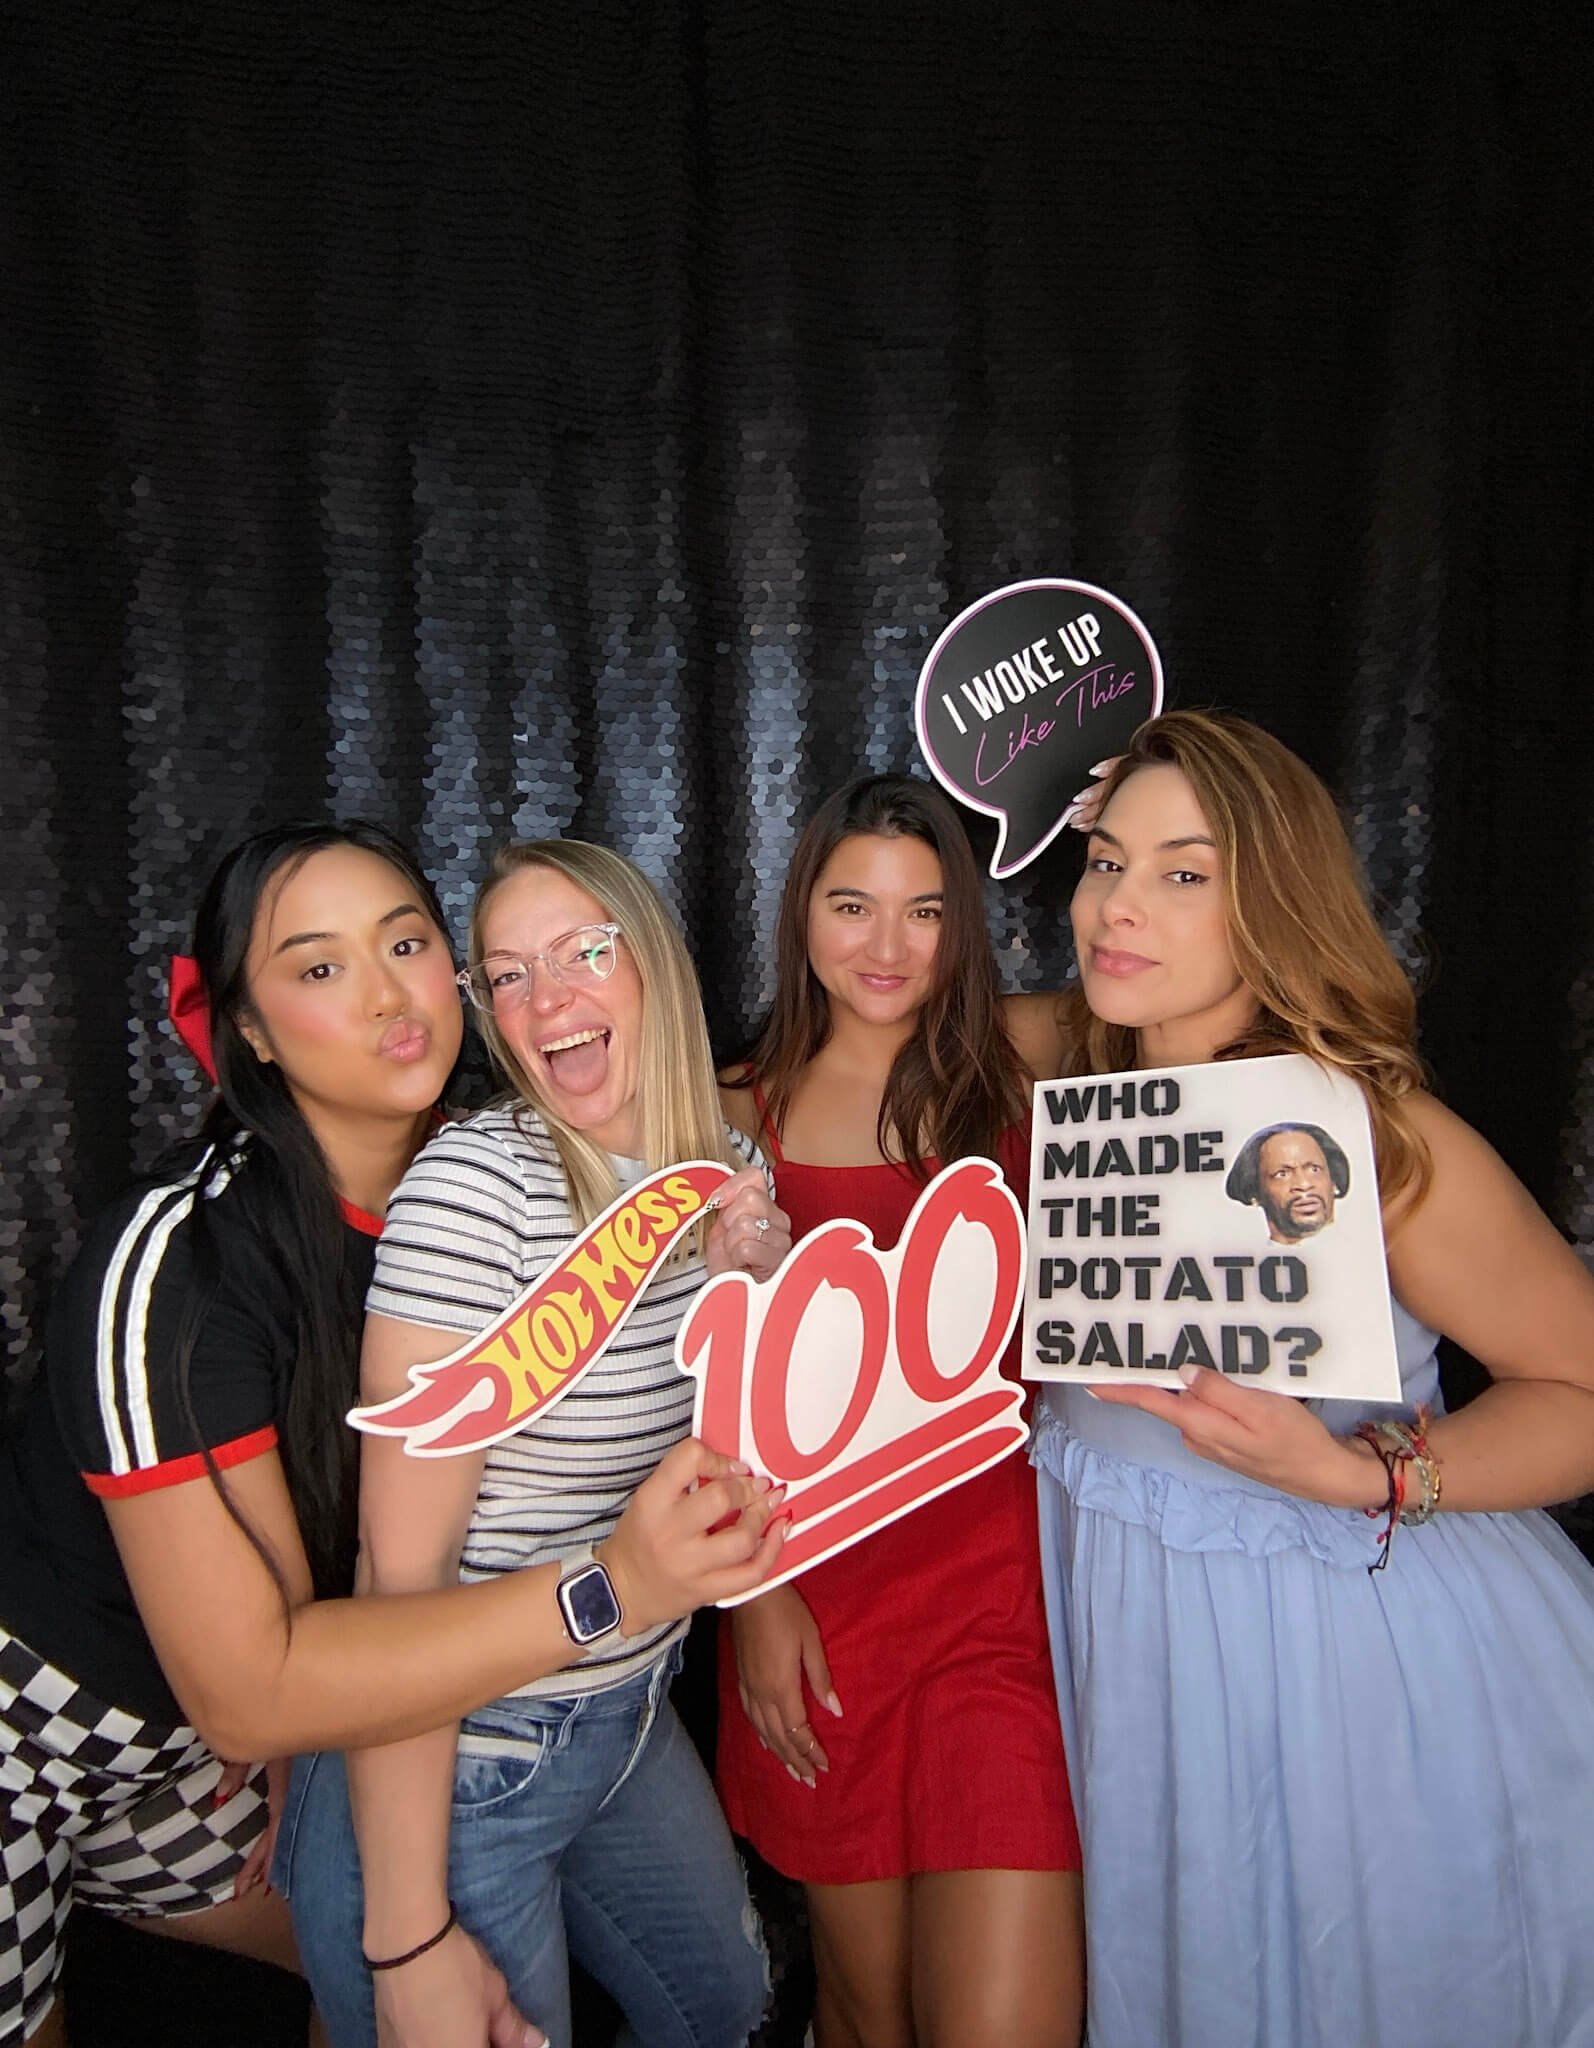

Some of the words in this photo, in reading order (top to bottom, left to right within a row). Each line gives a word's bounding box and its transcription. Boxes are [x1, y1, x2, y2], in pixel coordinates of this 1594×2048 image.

[942, 693, 968, 735] I
[960, 638, 1065, 722] WOKE
[1057, 612, 1102, 666] UP
[975, 713, 1056, 786] Like
[1055, 663, 1136, 728] This
[1043, 1077, 1181, 1125] WHO
[1043, 1131, 1225, 1180] MADE
[1040, 1194, 1161, 1238] THE
[1038, 1255, 1309, 1303] POTATO
[682, 1163, 1022, 1482] 100
[1035, 1320, 1323, 1377] SALAD?
